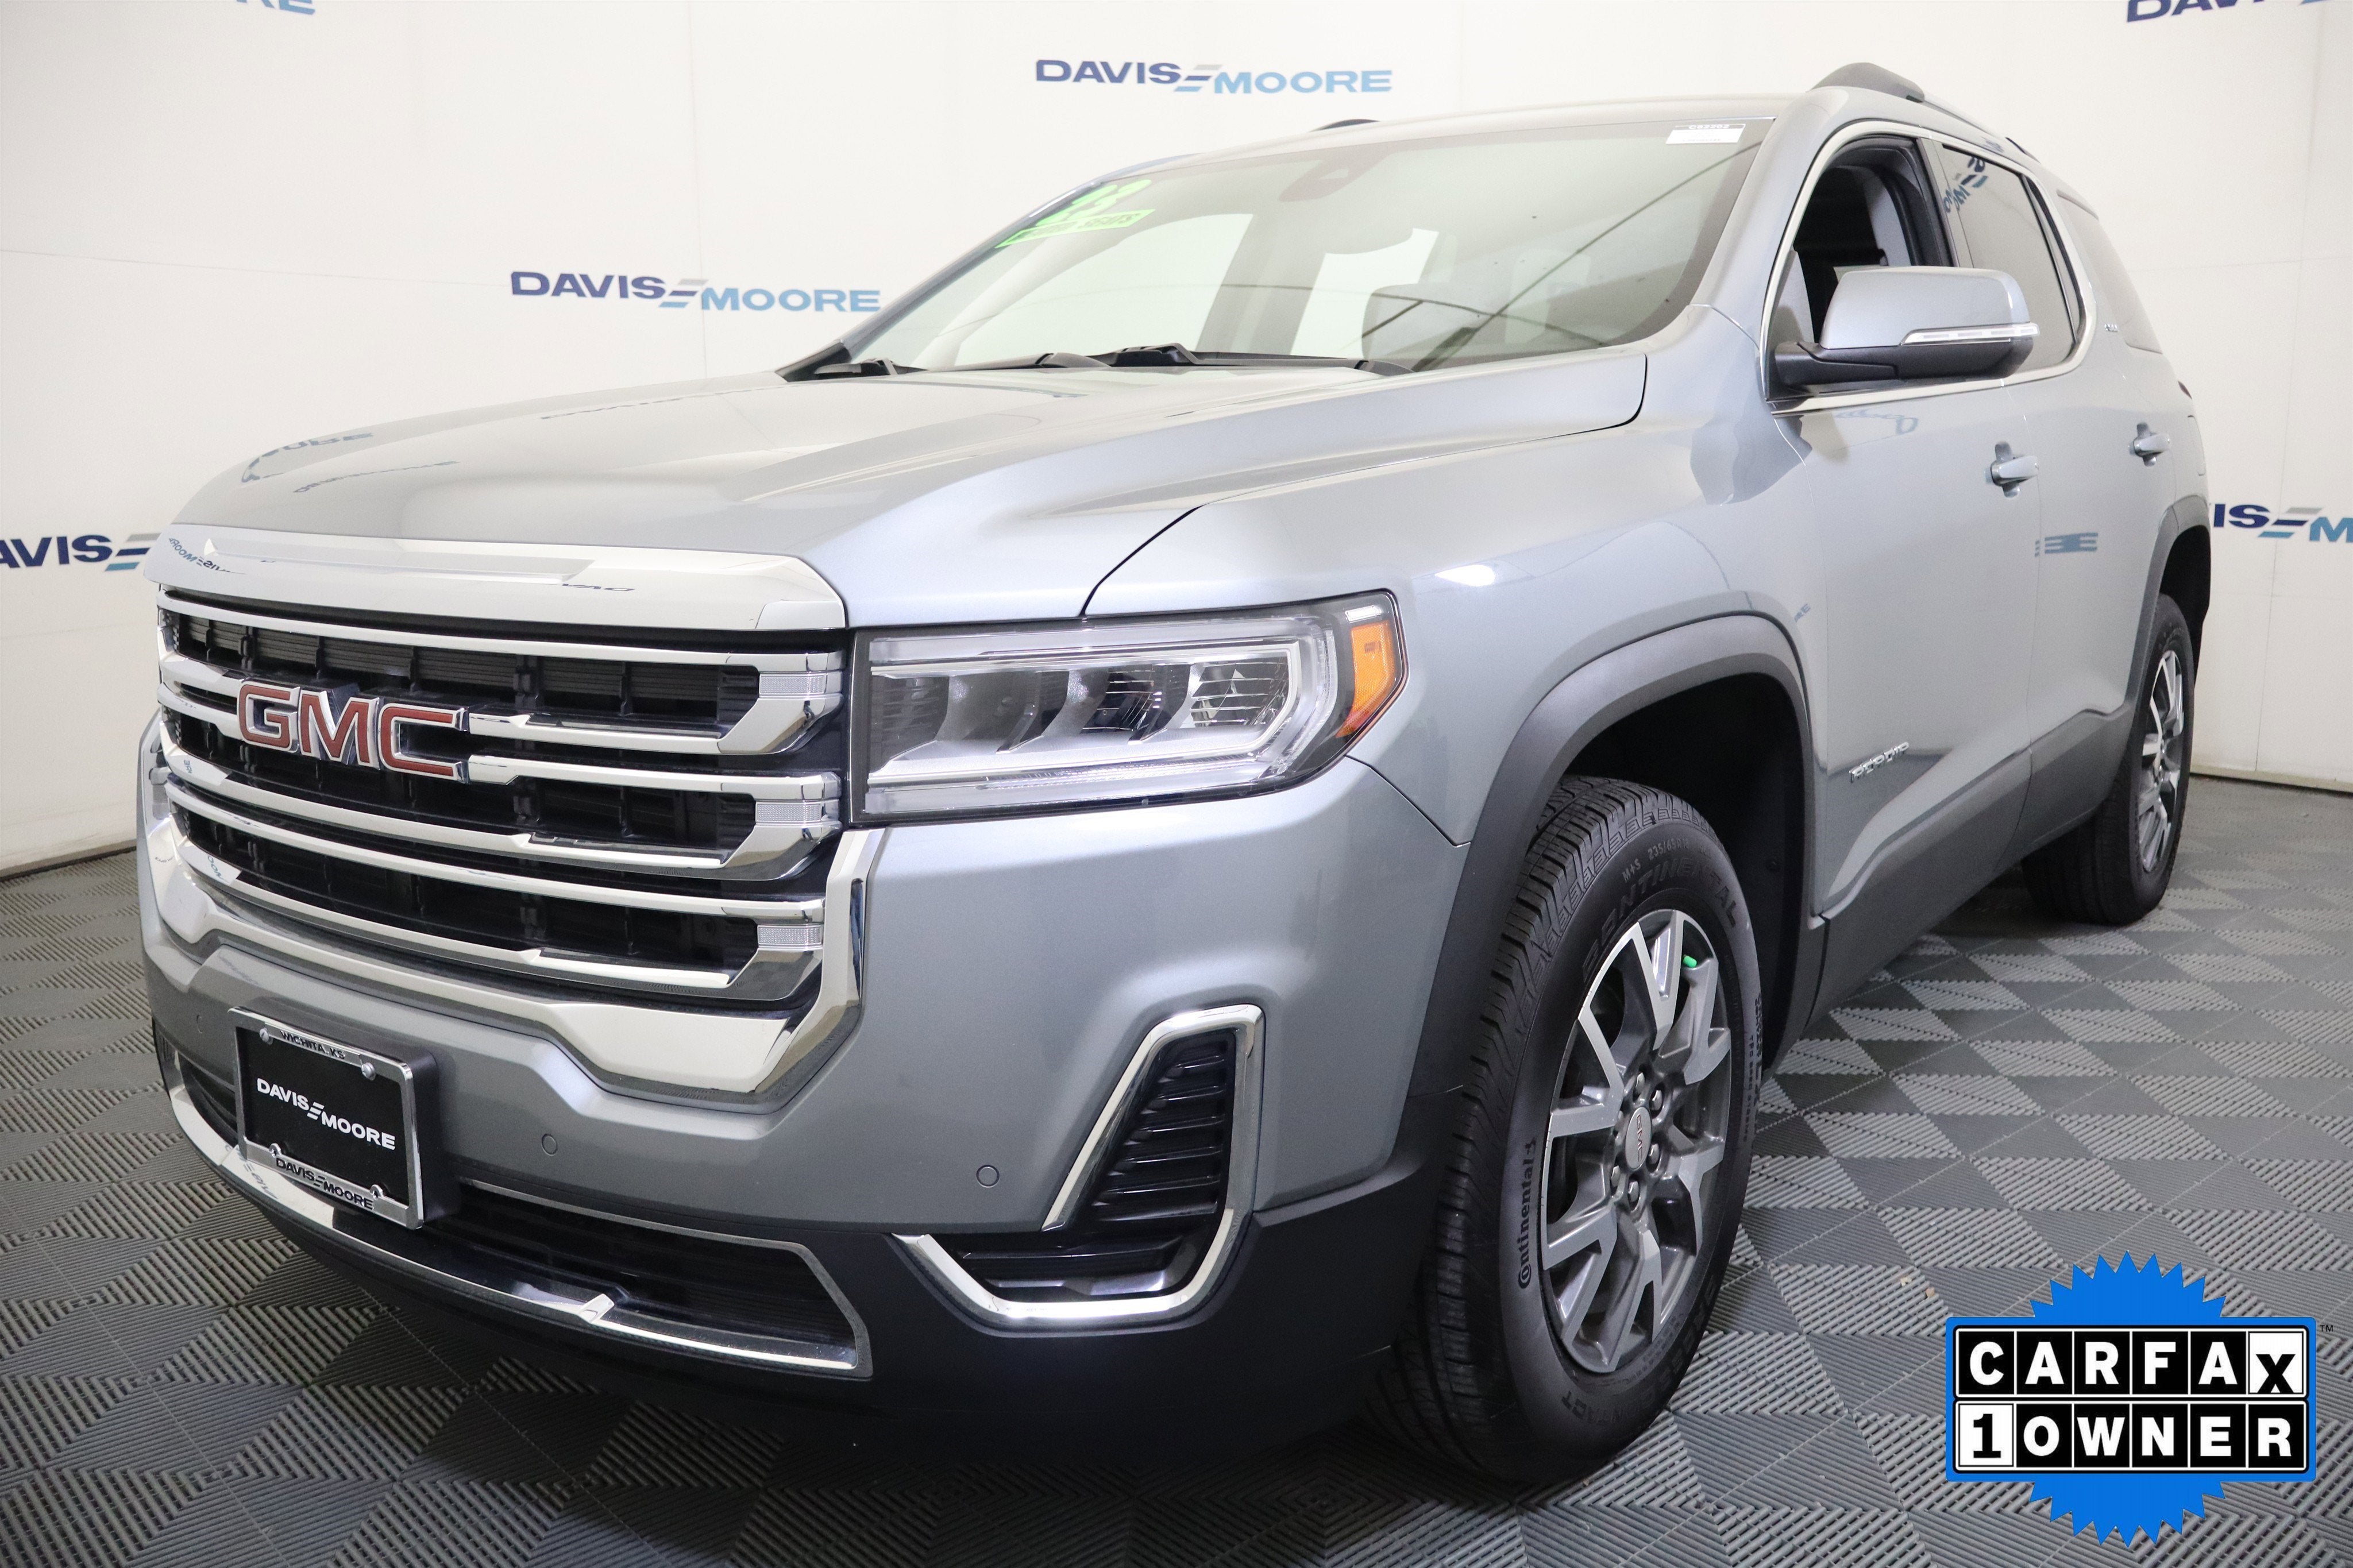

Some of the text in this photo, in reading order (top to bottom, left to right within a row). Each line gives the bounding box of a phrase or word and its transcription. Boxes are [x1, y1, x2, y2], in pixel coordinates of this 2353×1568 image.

[1036, 59, 1392, 94] DAVIS MOORE
[511, 271, 881, 313] DAVIS MOORE
[0, 535, 113, 569] AVIS
[237, 678, 469, 784] GMC
[330, 1047, 345, 1060] KS
[257, 1077, 396, 1150] DAVIS MOORE
[276, 1157, 315, 1181] DAVIS
[323, 1181, 375, 1210] MOORE
[1517, 1158, 1534, 1289] Continental
